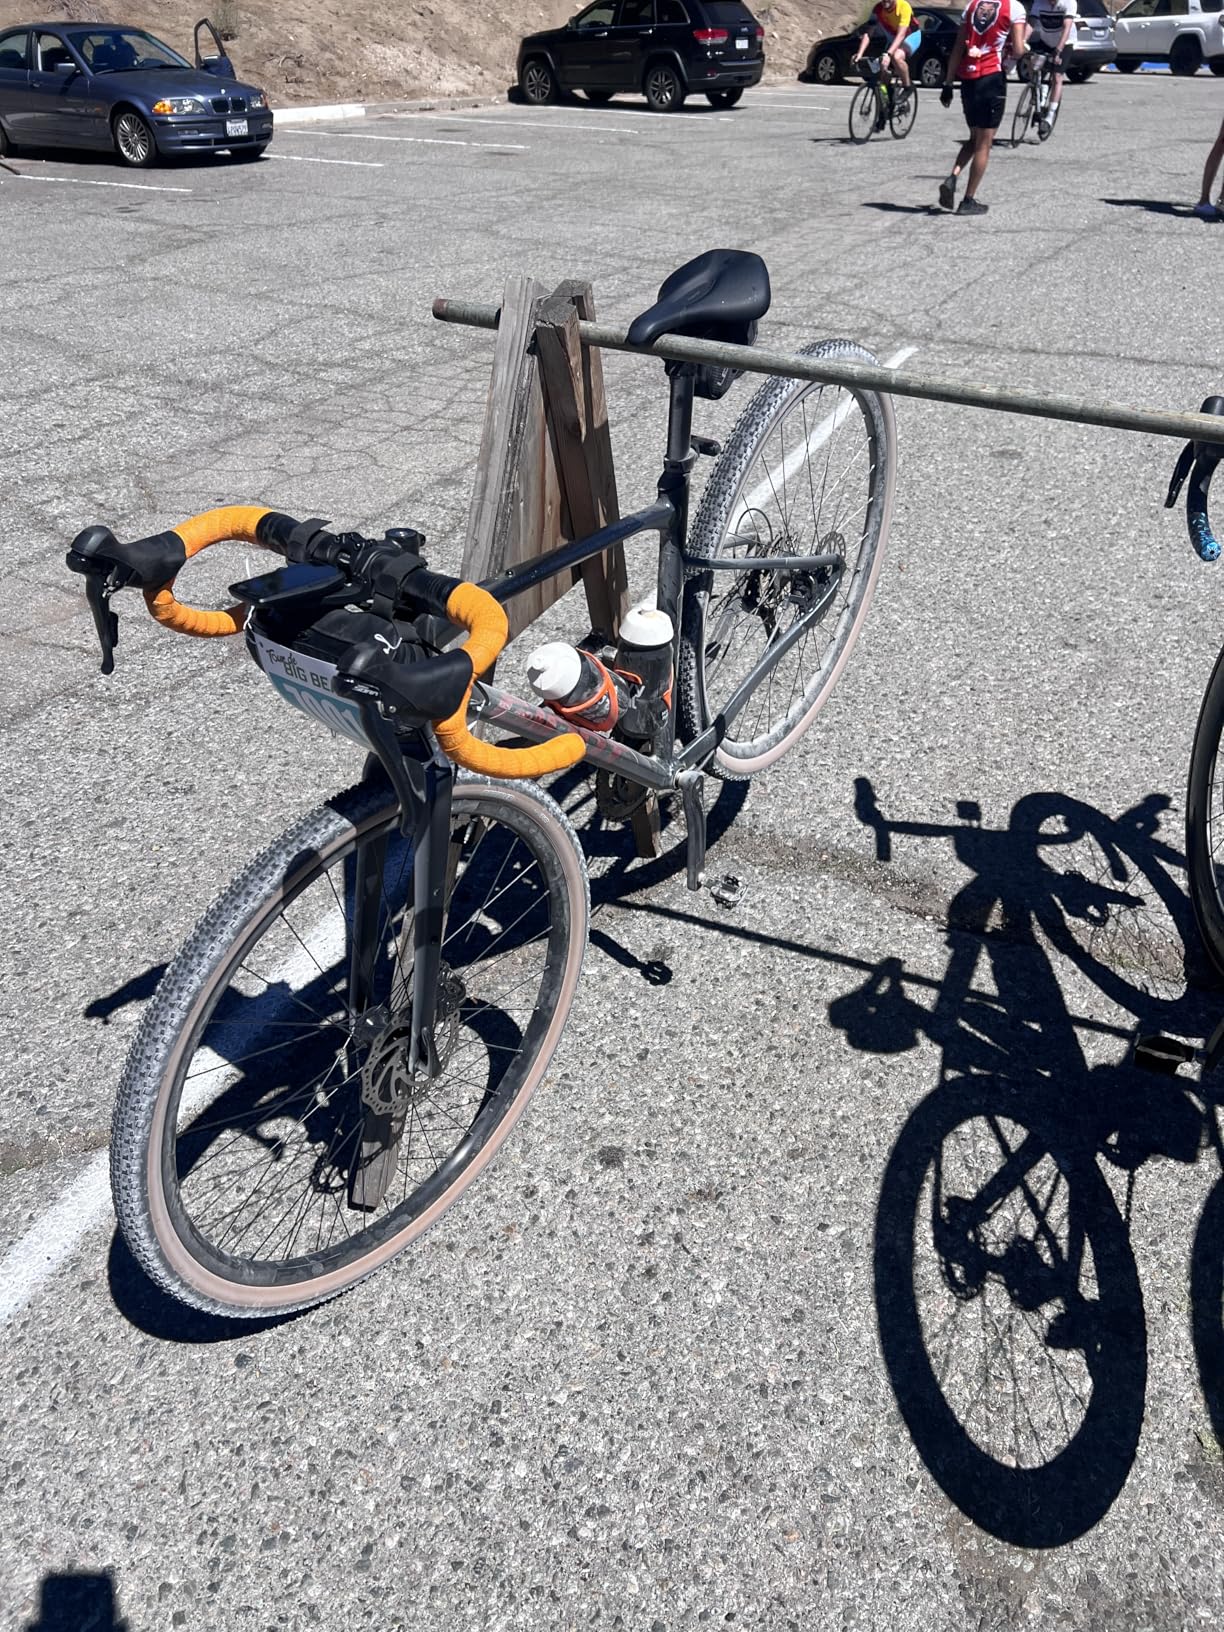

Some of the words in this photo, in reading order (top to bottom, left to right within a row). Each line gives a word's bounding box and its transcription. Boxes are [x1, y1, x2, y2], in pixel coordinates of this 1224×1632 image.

[266, 649, 286, 664] Tour
[288, 653, 297, 665] de
[284, 663, 307, 682] BIG
[310, 672, 333, 692] BE
